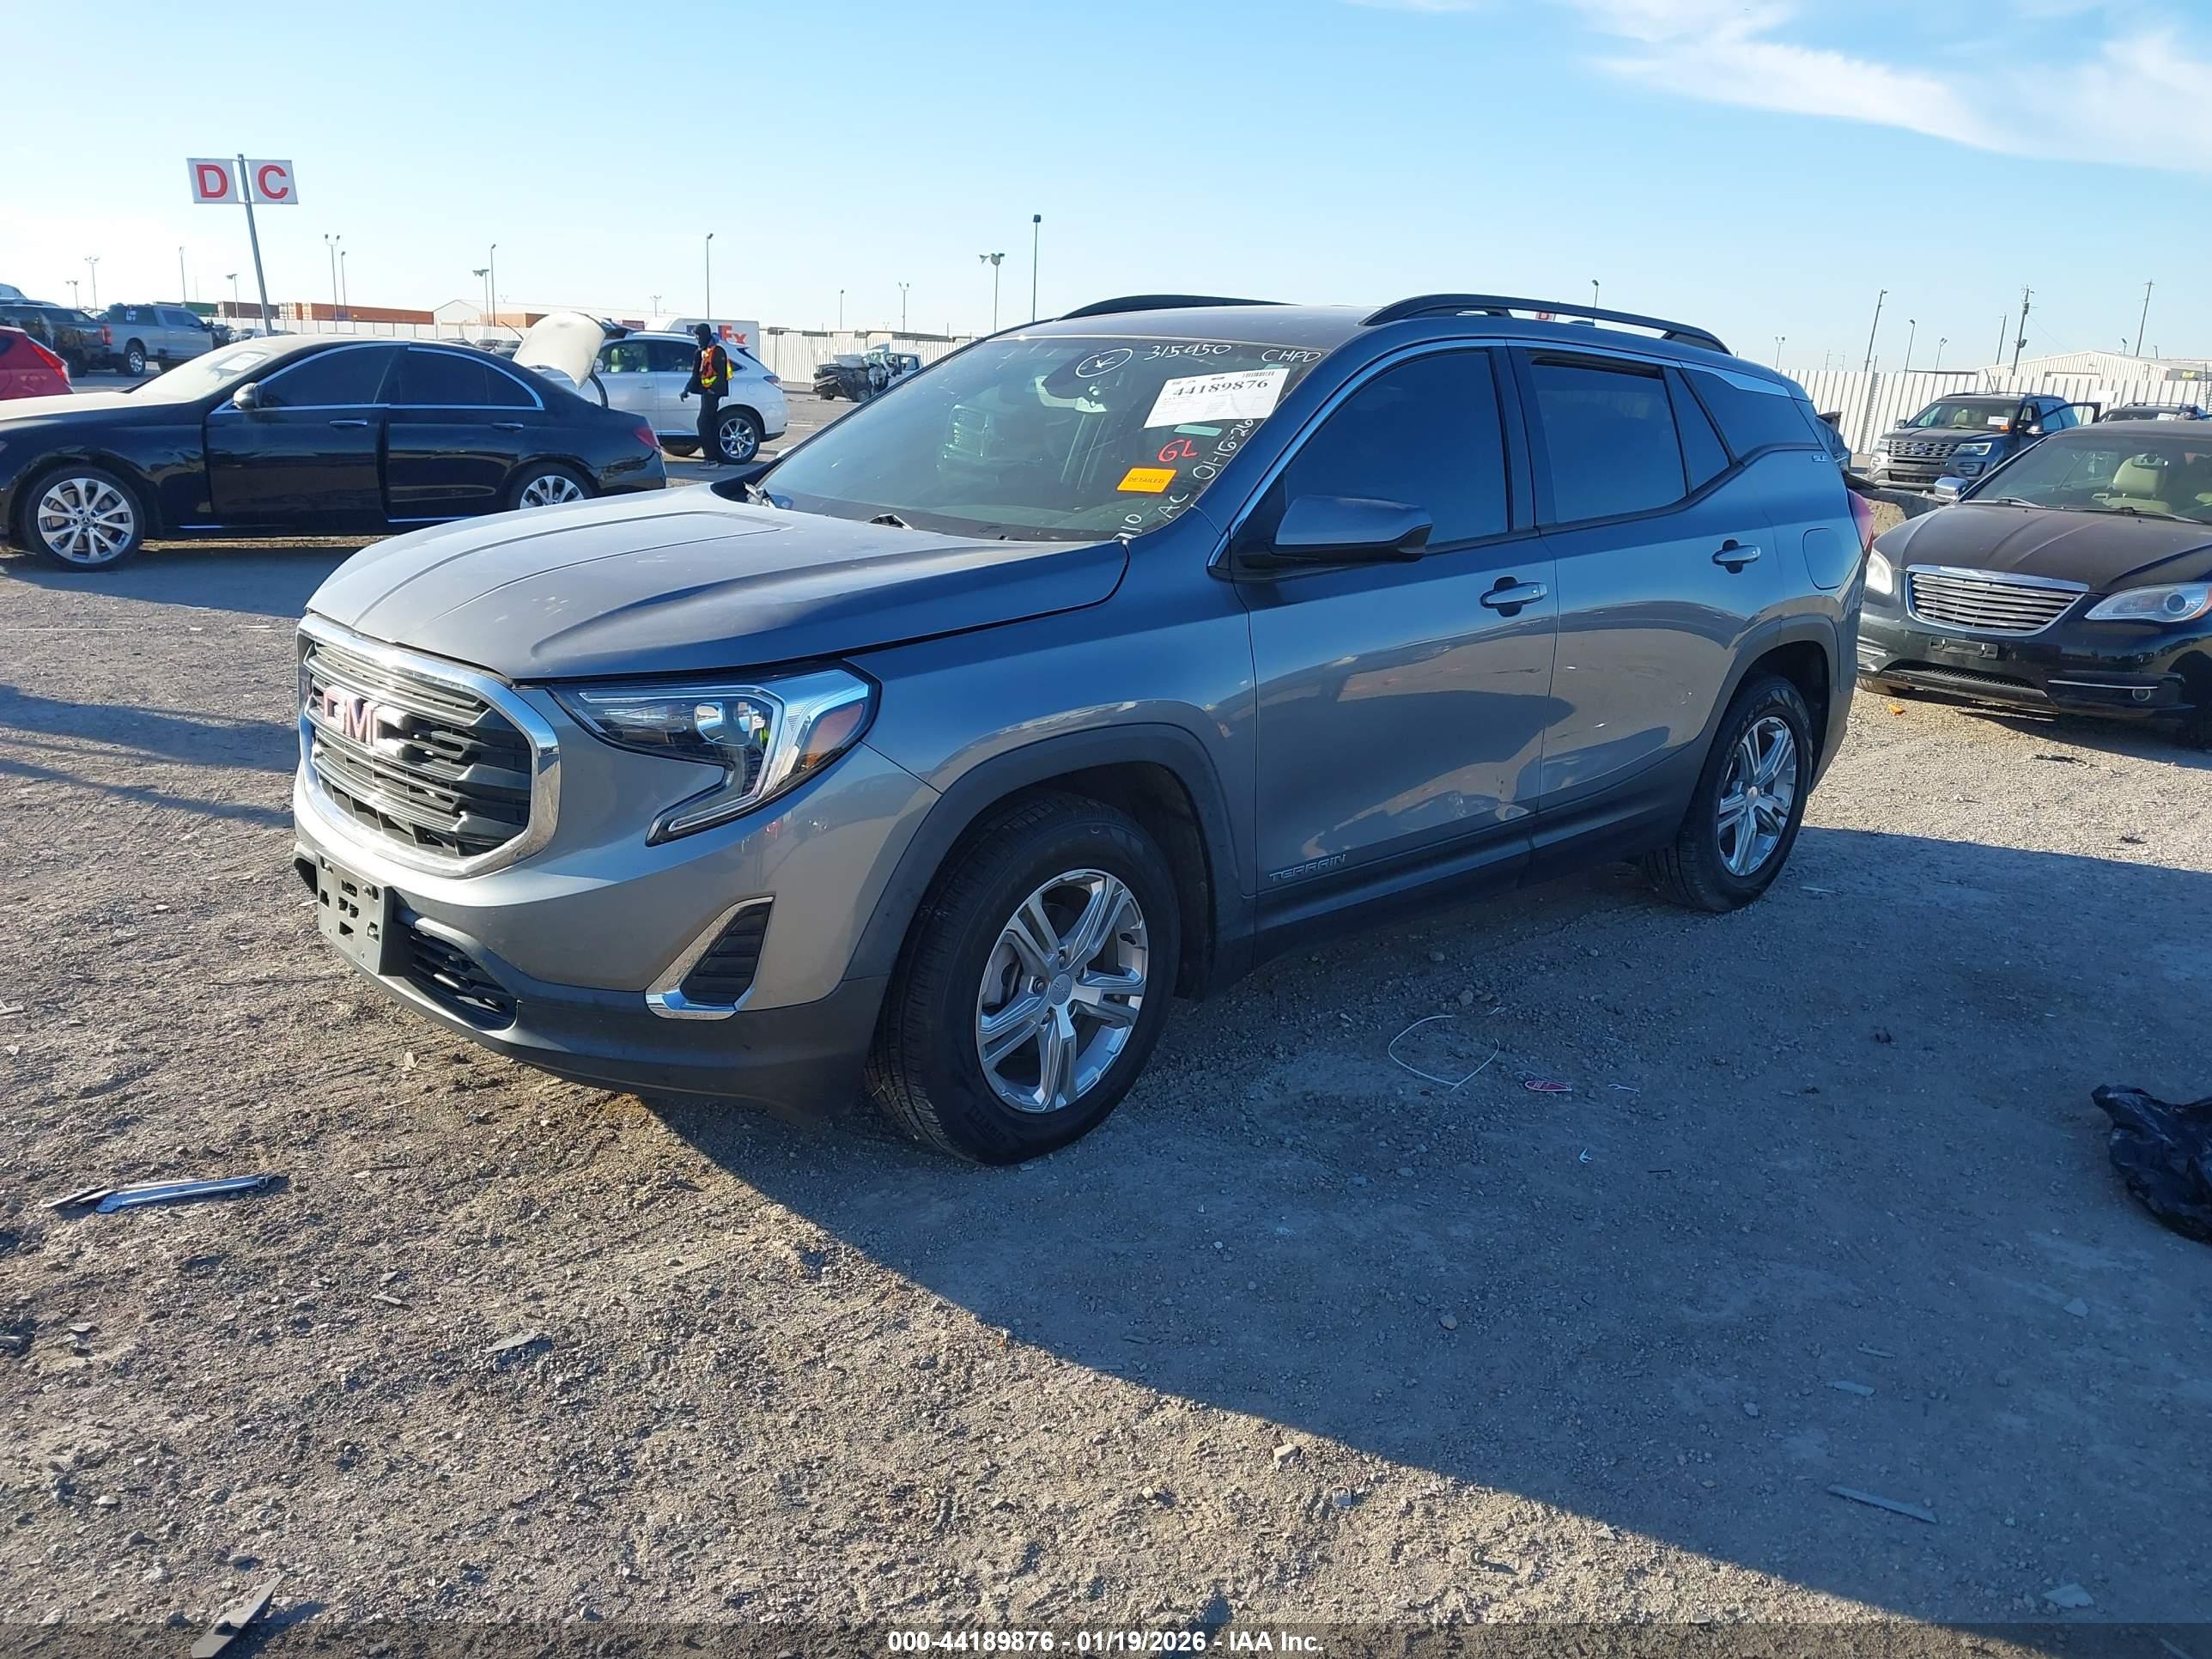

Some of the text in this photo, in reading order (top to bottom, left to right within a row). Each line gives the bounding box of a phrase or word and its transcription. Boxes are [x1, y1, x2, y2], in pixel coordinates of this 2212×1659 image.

[196, 164, 228, 198] D
[258, 164, 289, 199] C
[1143, 343, 1232, 361] 315450
[1261, 349, 1322, 362] CHPD
[1172, 379, 1269, 397] 44189876
[1127, 476, 1166, 485] DETAILED
[322, 684, 409, 763] GMC
[1268, 853, 1346, 884] TERRAIN
